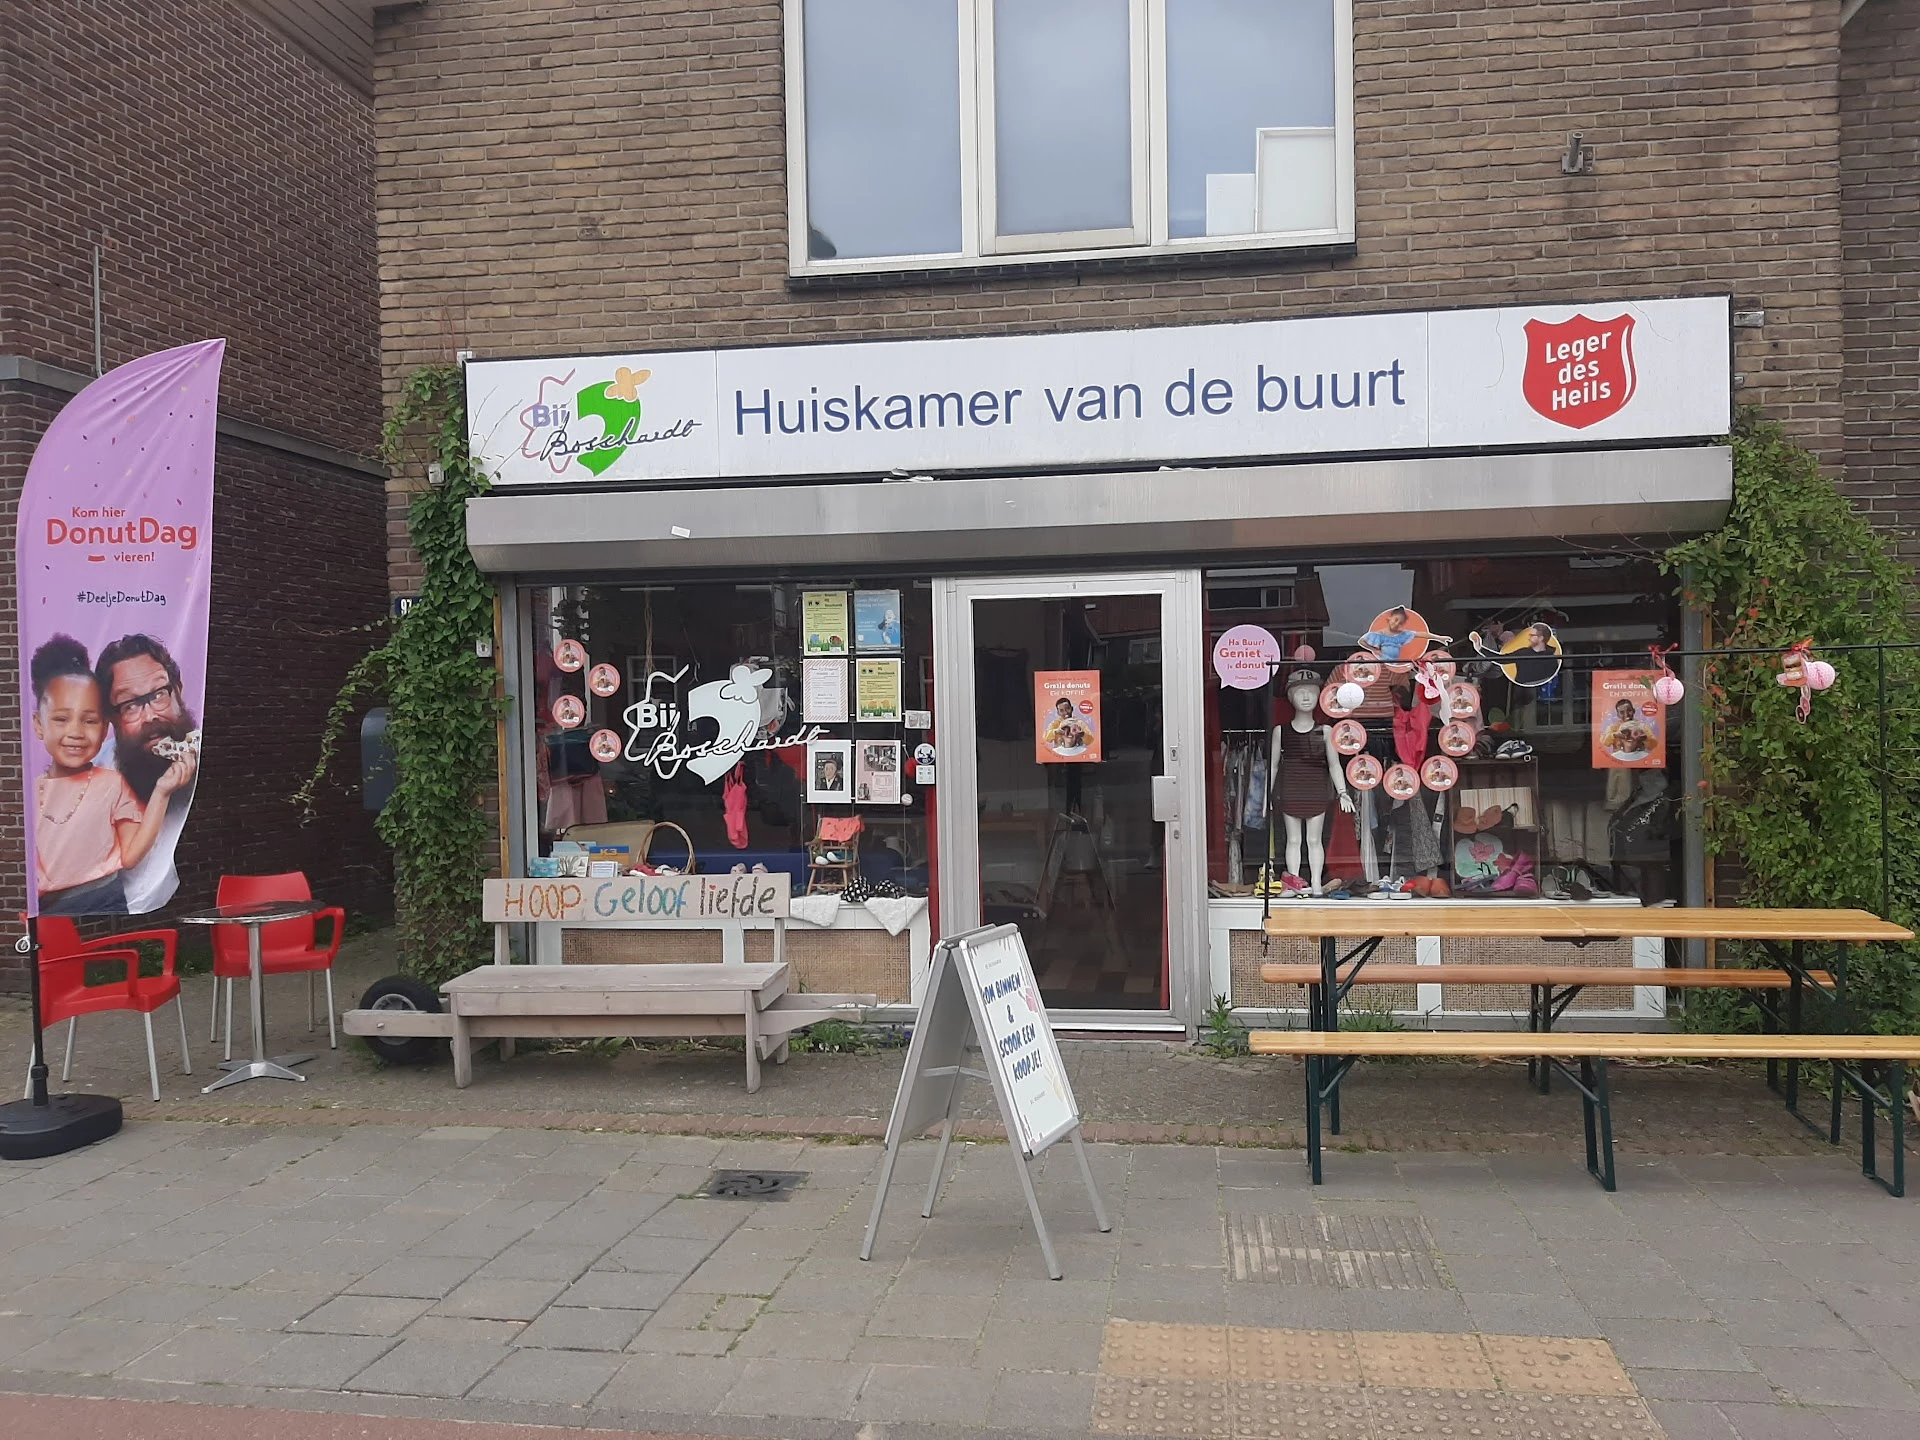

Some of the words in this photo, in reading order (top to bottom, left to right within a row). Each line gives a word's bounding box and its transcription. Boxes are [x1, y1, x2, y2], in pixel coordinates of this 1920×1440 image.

[1545, 331, 1612, 363] Leger
[1558, 360, 1600, 384] des
[735, 385, 1022, 435] Huiskamer
[1044, 383, 1142, 423] van
[1165, 368, 1233, 417] de
[1256, 359, 1405, 412] buurt
[1552, 380, 1611, 411] Heils
[532, 404, 567, 429] Bij
[72, 507, 99, 518] Kom
[102, 507, 126, 518] hier
[47, 517, 197, 550] DonutDag
[113, 552, 155, 562] vieren!
[76, 591, 167, 607] #DeeljeDonutDag
[1219, 648, 1261, 658] Geniet
[1235, 661, 1266, 669] donut
[1043, 682, 1066, 690] Gratis
[1603, 682, 1627, 690] Gratis
[637, 703, 677, 729] Bij
[505, 882, 582, 920] HOOP
[593, 878, 690, 918] Geloof
[700, 876, 776, 918] liefde
[995, 972, 1021, 999] BINNEN
[1007, 1004, 1014, 1023] &
[999, 1032, 1023, 1059] SCOOR
[1022, 1022, 1036, 1045] EEN
[1012, 1048, 1042, 1083] KOOPJE!
